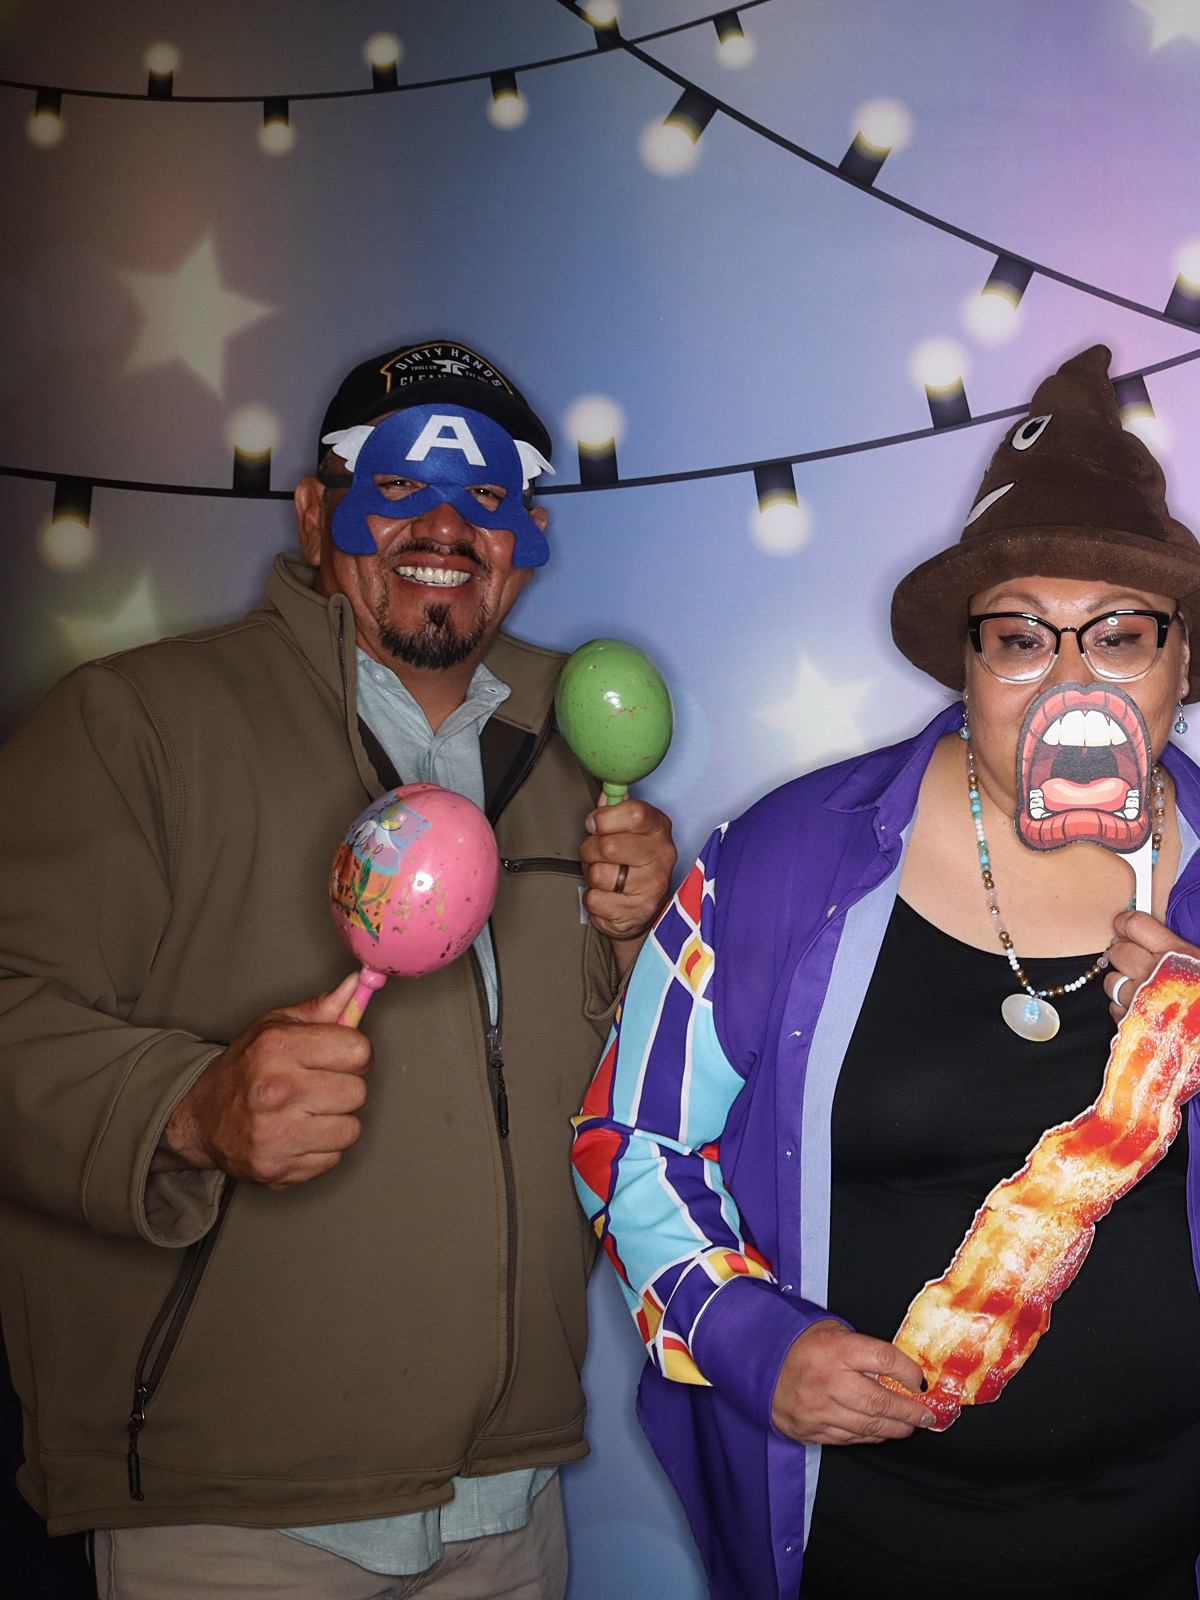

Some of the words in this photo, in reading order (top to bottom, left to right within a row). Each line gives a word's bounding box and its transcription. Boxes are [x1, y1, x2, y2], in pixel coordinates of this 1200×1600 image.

[394, 347, 442, 370] DIRTY
[450, 348, 502, 387] HANDS
[404, 413, 488, 467] A
